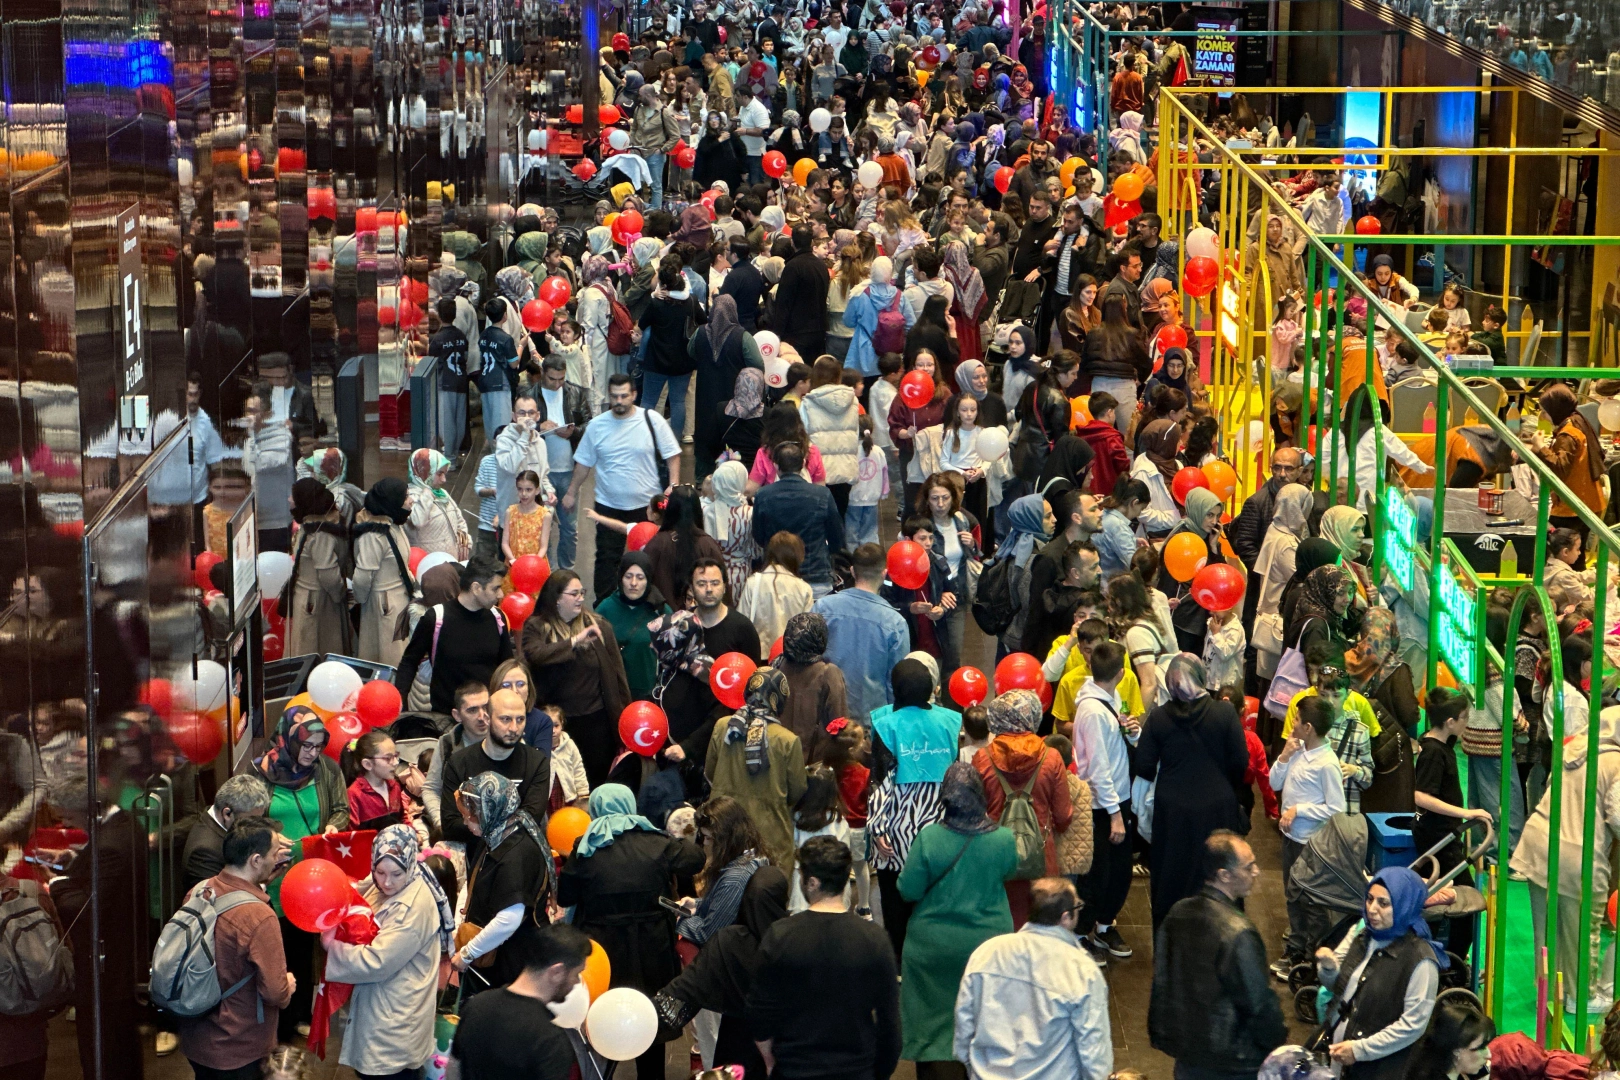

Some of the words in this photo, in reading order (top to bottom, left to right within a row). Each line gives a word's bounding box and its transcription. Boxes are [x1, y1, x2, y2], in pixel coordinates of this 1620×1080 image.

[1196, 39, 1235, 52] KOMEK
[1196, 51, 1223, 61] KAYIT
[1195, 60, 1235, 73] ZAMANI
[123, 273, 141, 359] E4
[1479, 536, 1499, 552] aile
[900, 741, 950, 761] bilgehane
